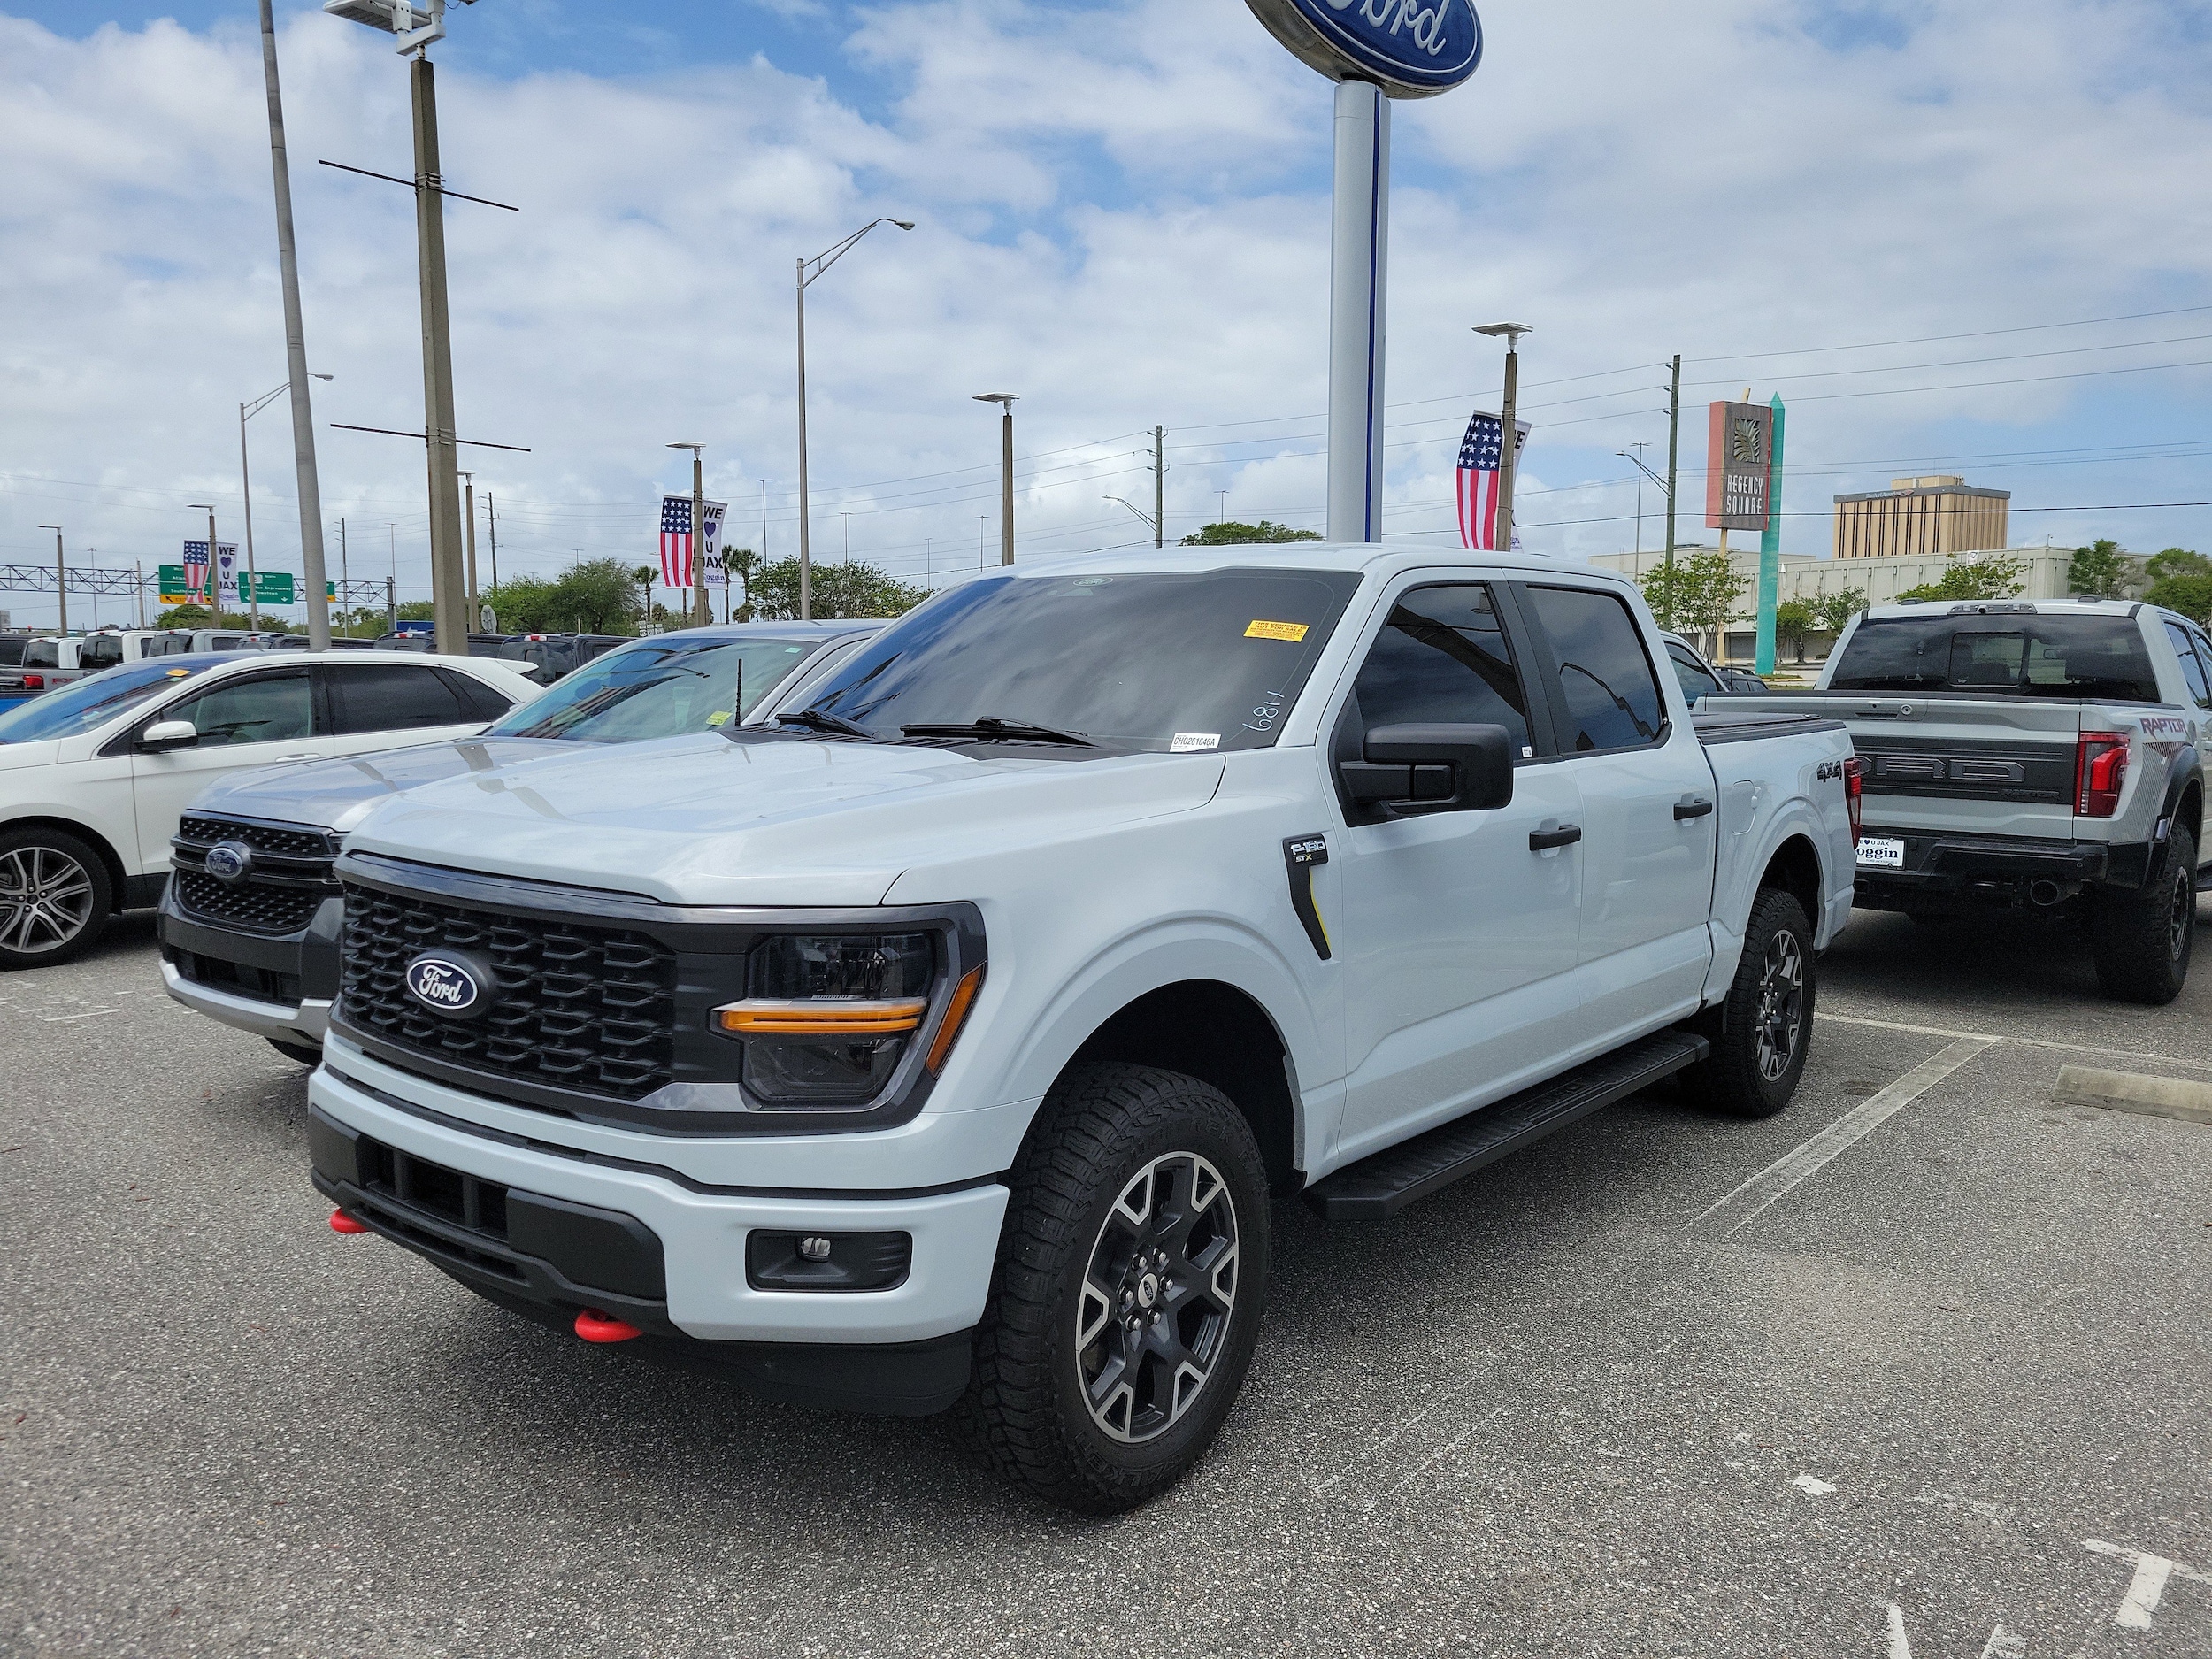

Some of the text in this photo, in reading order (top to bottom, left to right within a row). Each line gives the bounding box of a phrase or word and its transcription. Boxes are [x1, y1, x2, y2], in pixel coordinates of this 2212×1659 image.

[1727, 475, 1763, 495] REGENCY
[1726, 495, 1762, 515] SQUARE
[703, 505, 723, 520] WE
[219, 546, 235, 556] WE
[705, 541, 713, 554] U
[222, 571, 230, 580] U
[218, 581, 238, 590] JAX
[2139, 717, 2191, 741] RAPTOR
[1295, 854, 1313, 863] STX
[1856, 847, 1898, 860] oggin
[419, 964, 464, 1003] Ford
